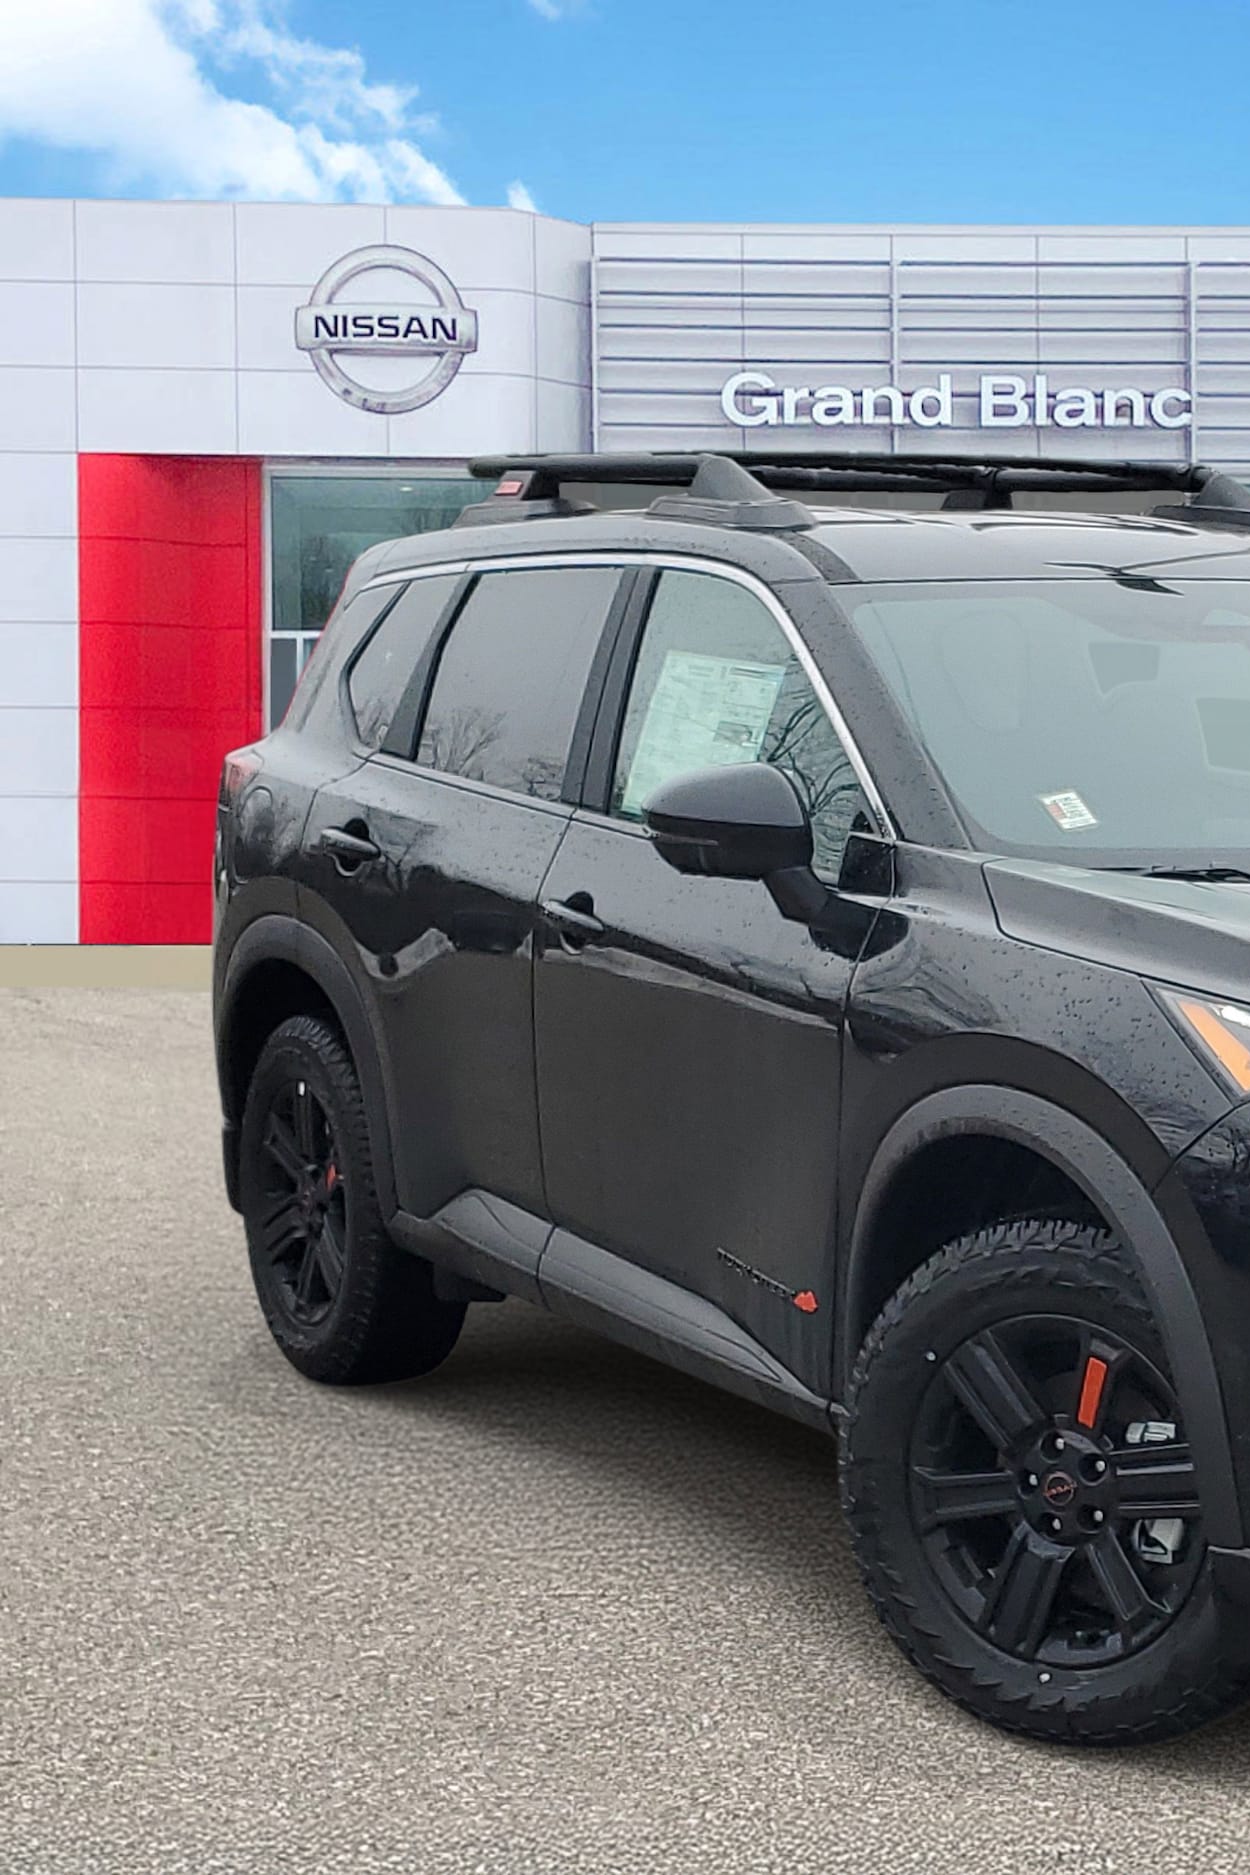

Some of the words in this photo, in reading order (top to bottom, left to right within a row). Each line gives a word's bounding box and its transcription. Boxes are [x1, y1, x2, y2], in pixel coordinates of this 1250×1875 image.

[314, 314, 458, 341] NISSAN
[720, 371, 952, 428] Grand
[980, 373, 1194, 429] Blanc
